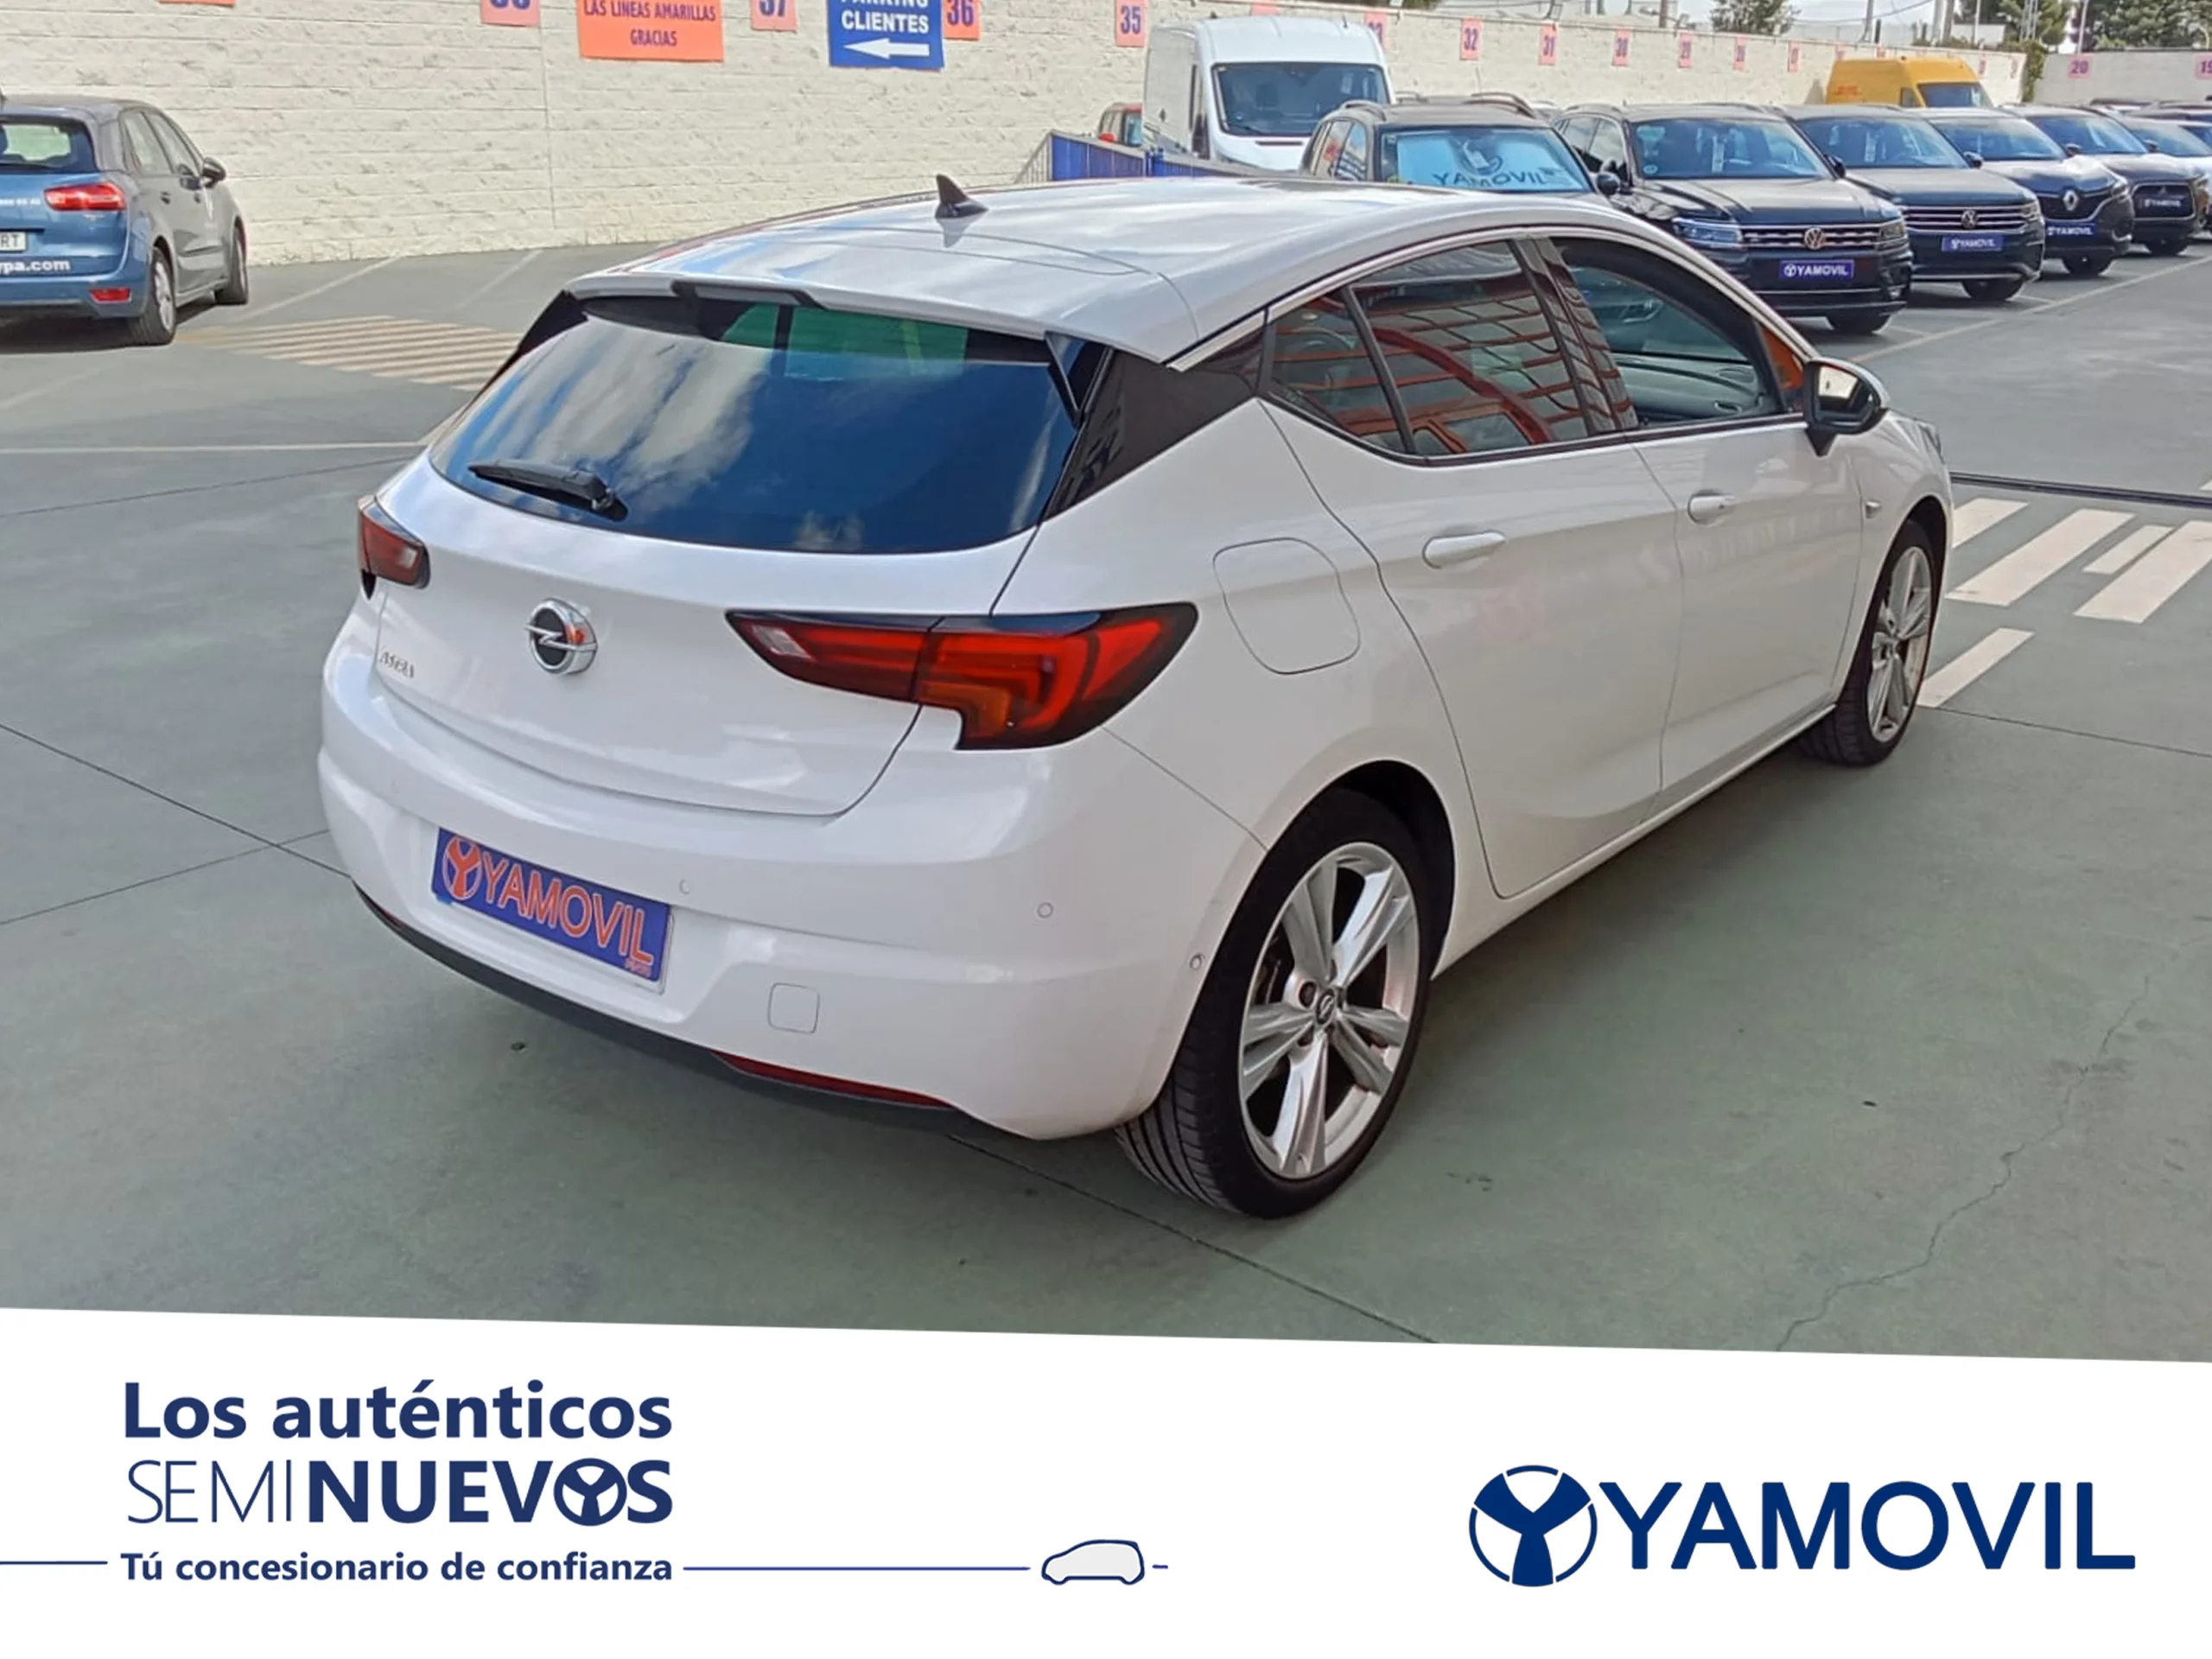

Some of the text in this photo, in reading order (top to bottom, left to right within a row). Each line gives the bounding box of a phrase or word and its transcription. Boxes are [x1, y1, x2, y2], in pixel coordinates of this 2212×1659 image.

[584, 0, 607, 16] LAS
[654, 3, 716, 22] AMARILLAS
[841, 10, 930, 34] CLIENTES
[947, 0, 974, 26] 36
[1120, 5, 1141, 34] 35
[630, 29, 677, 46] GRACIAS
[1464, 28, 1478, 51] 32
[1543, 35, 1555, 56] 31
[2070, 60, 2089, 74] 20
[1796, 264, 1849, 276] YAMOVIL
[481, 850, 653, 967] YAMOVIL
